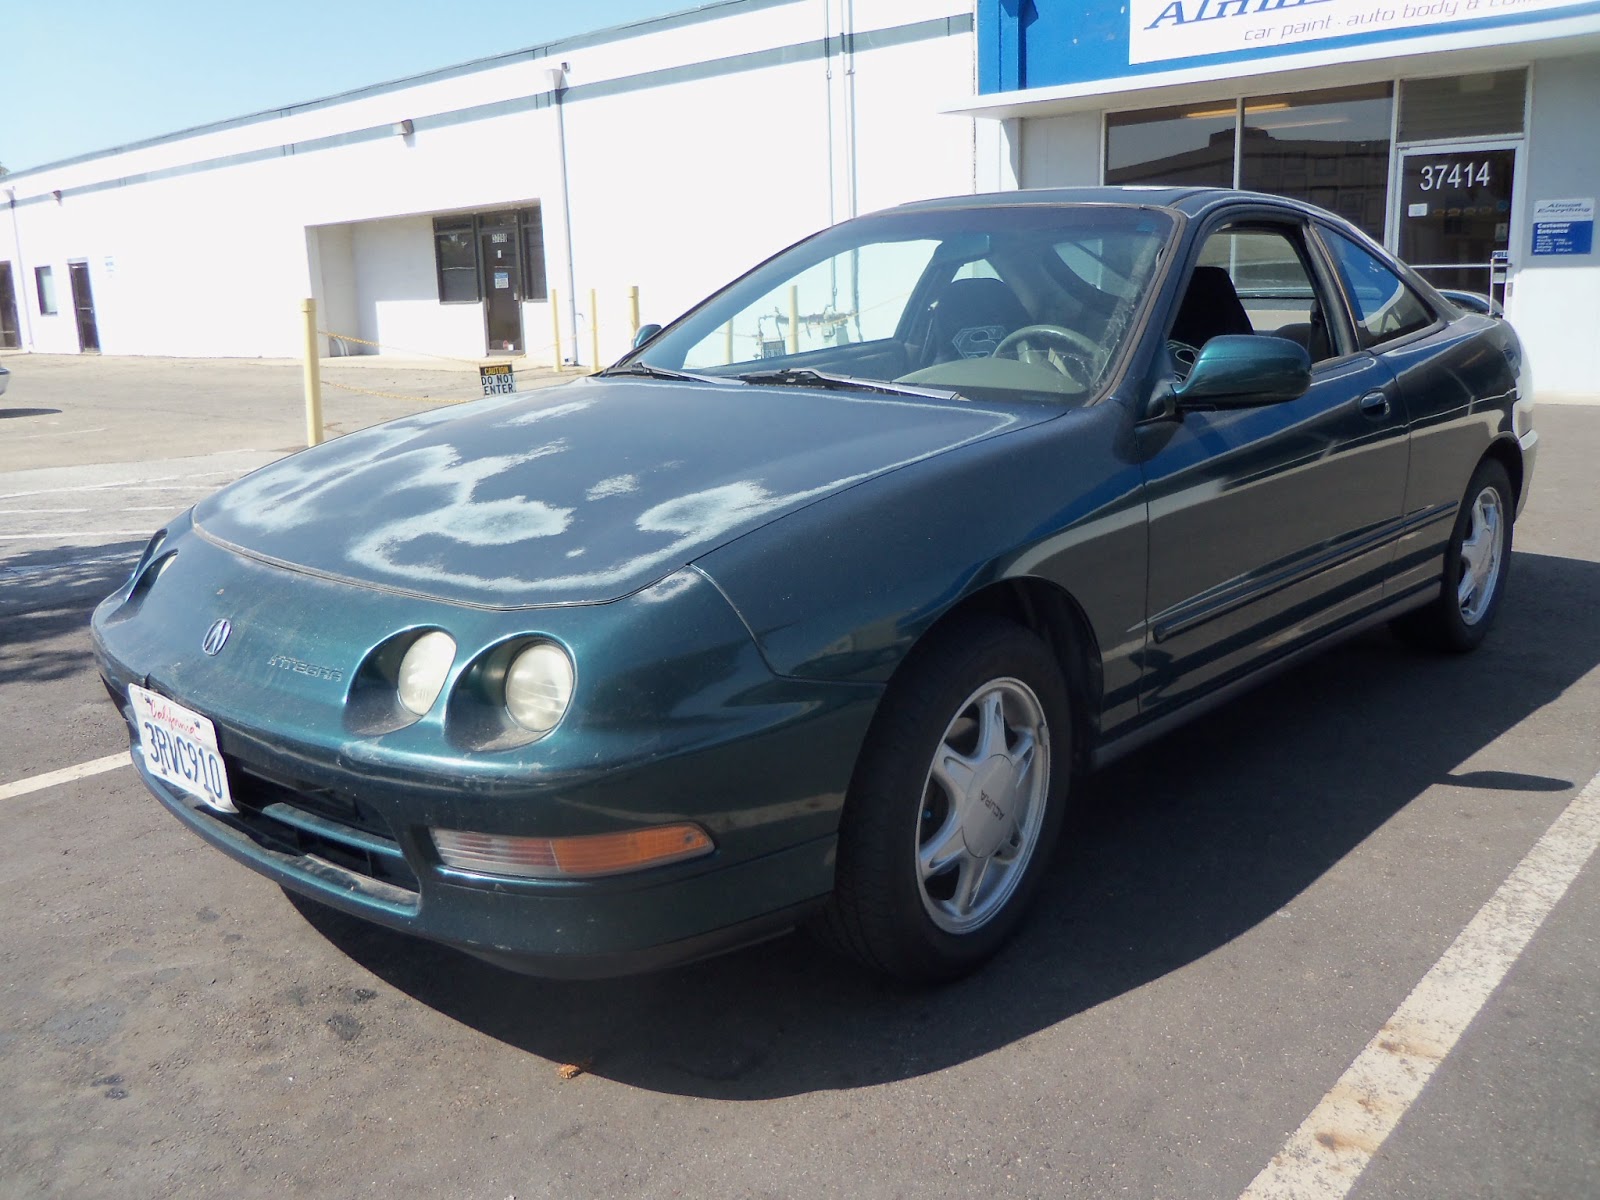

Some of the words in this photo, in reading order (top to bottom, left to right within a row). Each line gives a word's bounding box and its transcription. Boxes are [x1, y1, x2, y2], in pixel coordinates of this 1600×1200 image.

[1244, 27, 1276, 41] car
[1281, 15, 1333, 39] paint
[1346, 7, 1395, 27] auto
[1402, 1, 1458, 19] body
[1419, 161, 1490, 191] 37414
[481, 376, 493, 385] DO
[497, 374, 514, 383] NOT
[484, 384, 514, 395] ENTER
[149, 700, 202, 741] California
[144, 721, 223, 799] 3RVC910
[980, 789, 1005, 821] ACURA
